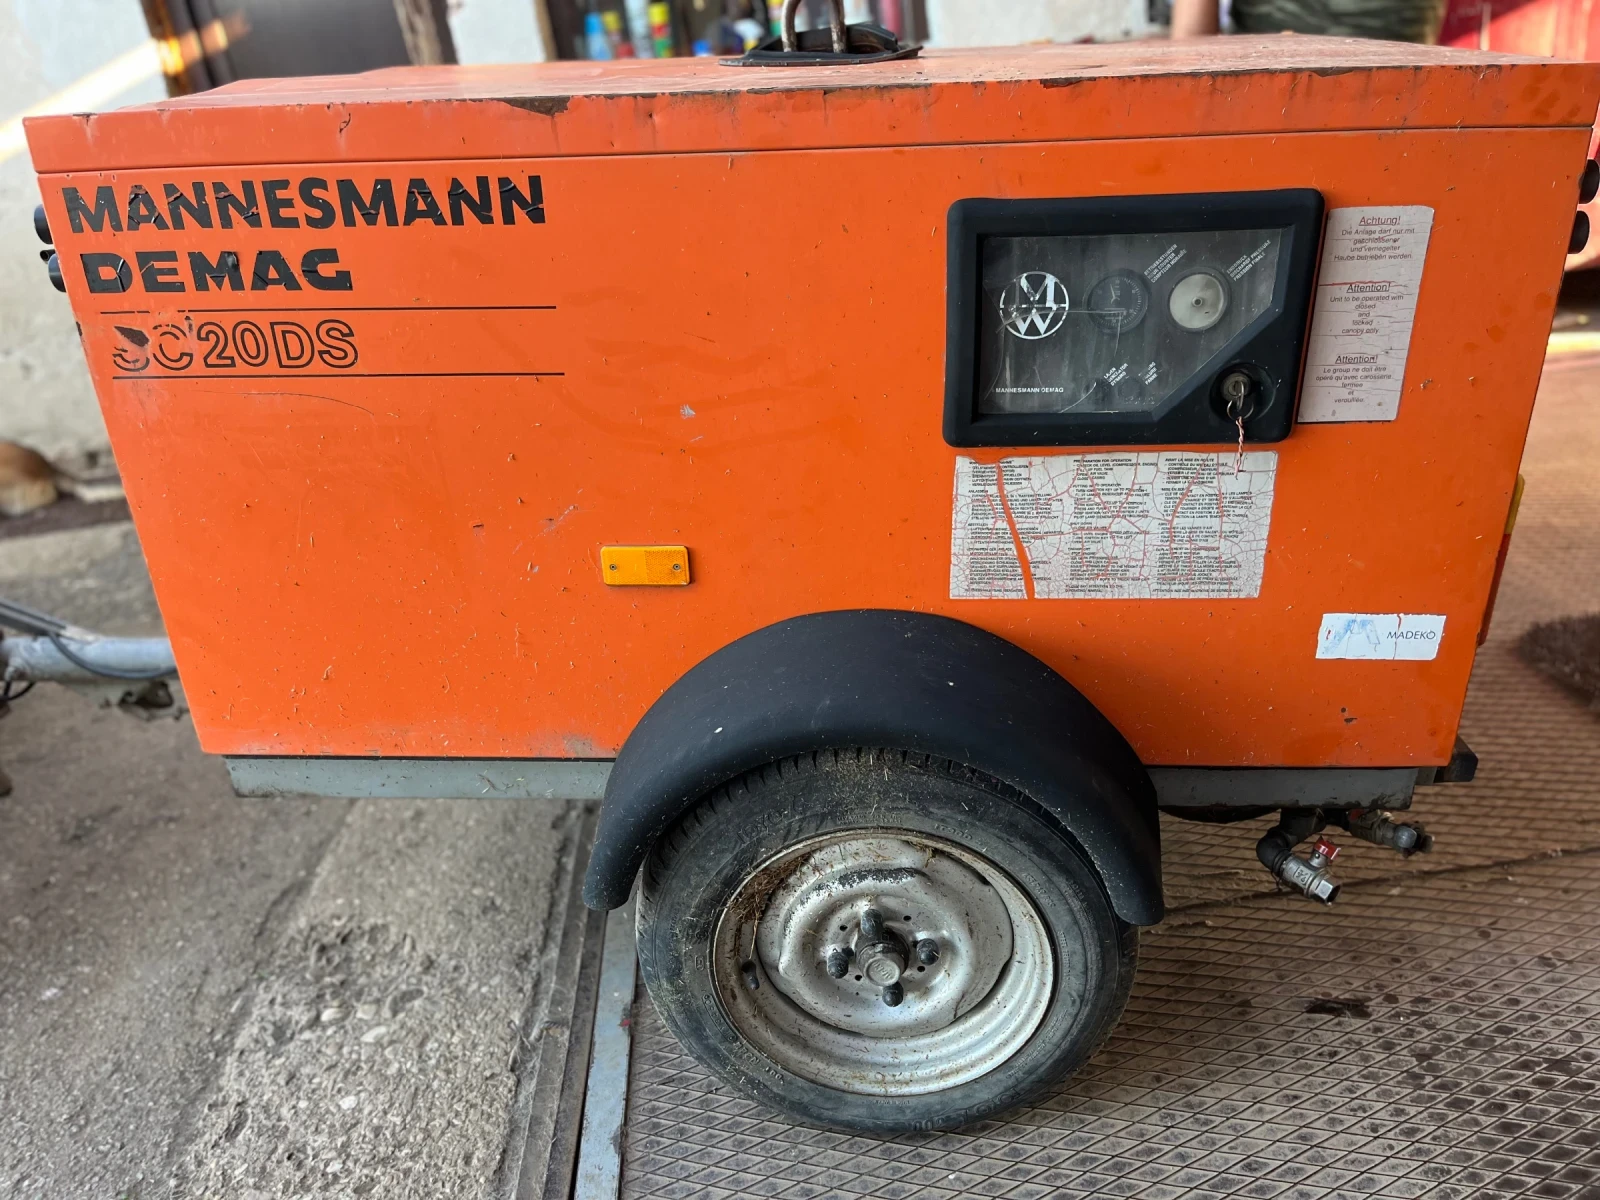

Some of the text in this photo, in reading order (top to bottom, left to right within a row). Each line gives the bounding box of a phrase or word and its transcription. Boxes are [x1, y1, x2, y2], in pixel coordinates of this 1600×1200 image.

[61, 175, 546, 234] MANNESMANN
[1359, 216, 1400, 226] Achtung!
[80, 248, 353, 293] DEMAG
[1346, 282, 1390, 292] Attention!
[1335, 355, 1378, 364] Attention!
